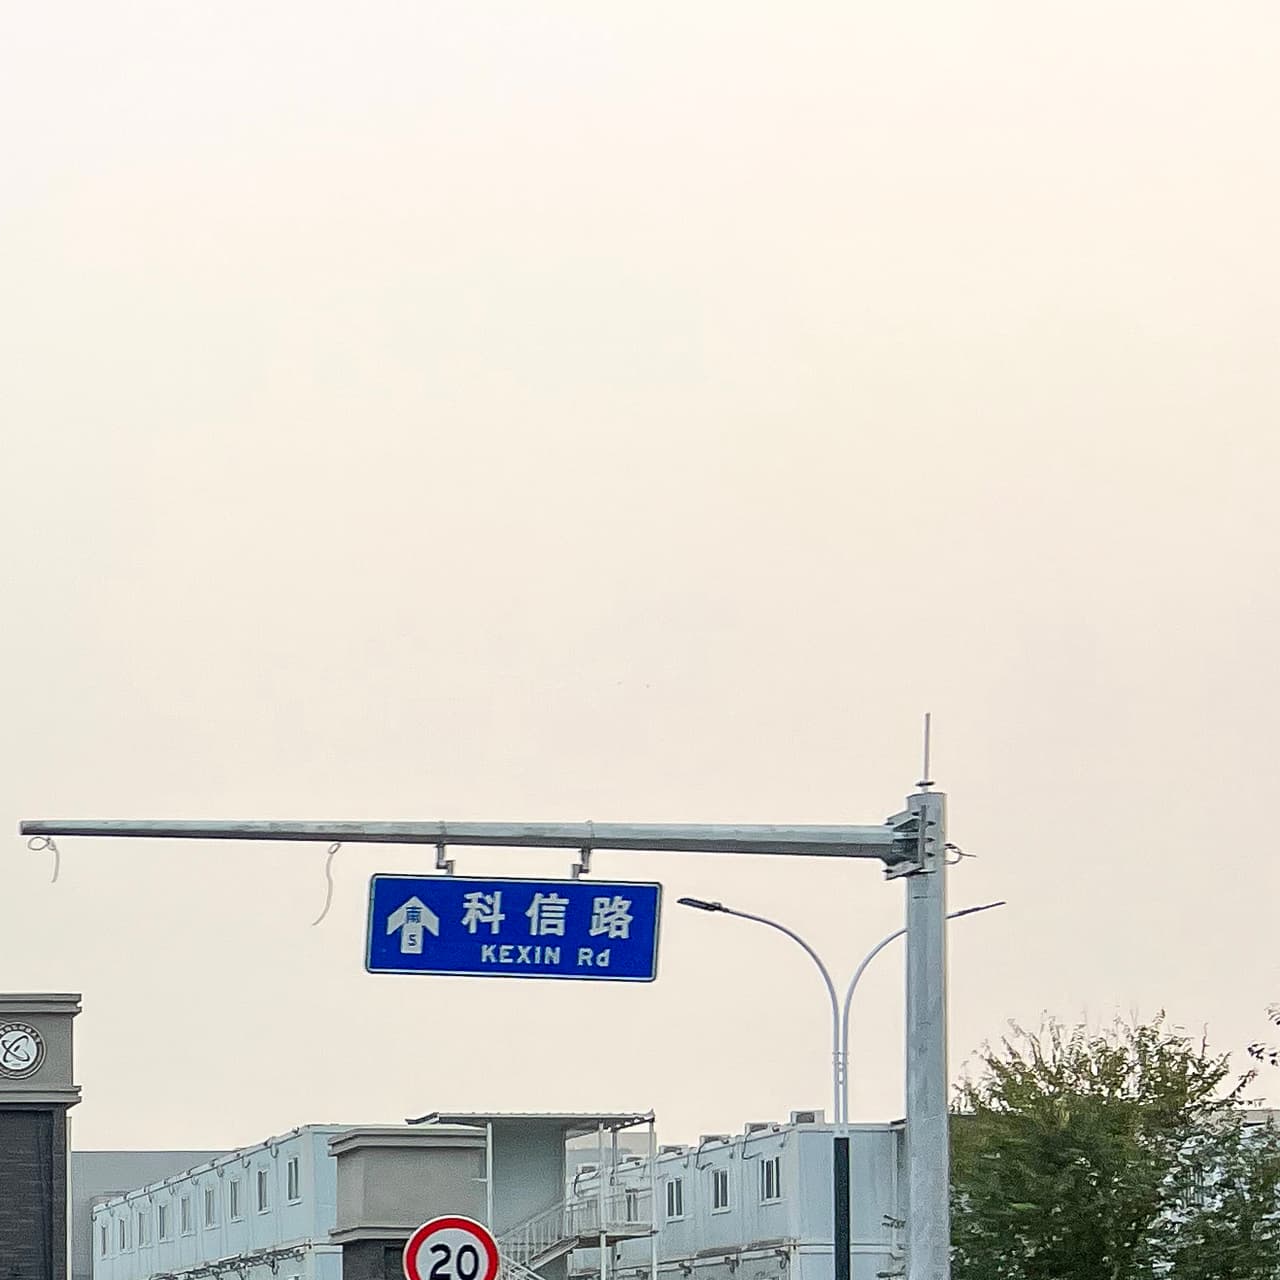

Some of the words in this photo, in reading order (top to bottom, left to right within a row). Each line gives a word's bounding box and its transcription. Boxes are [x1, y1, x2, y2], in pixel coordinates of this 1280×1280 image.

[461, 890, 634, 939] 科信路
[408, 933, 417, 947] S
[481, 944, 560, 965] KEXIN
[577, 948, 610, 967] Rd
